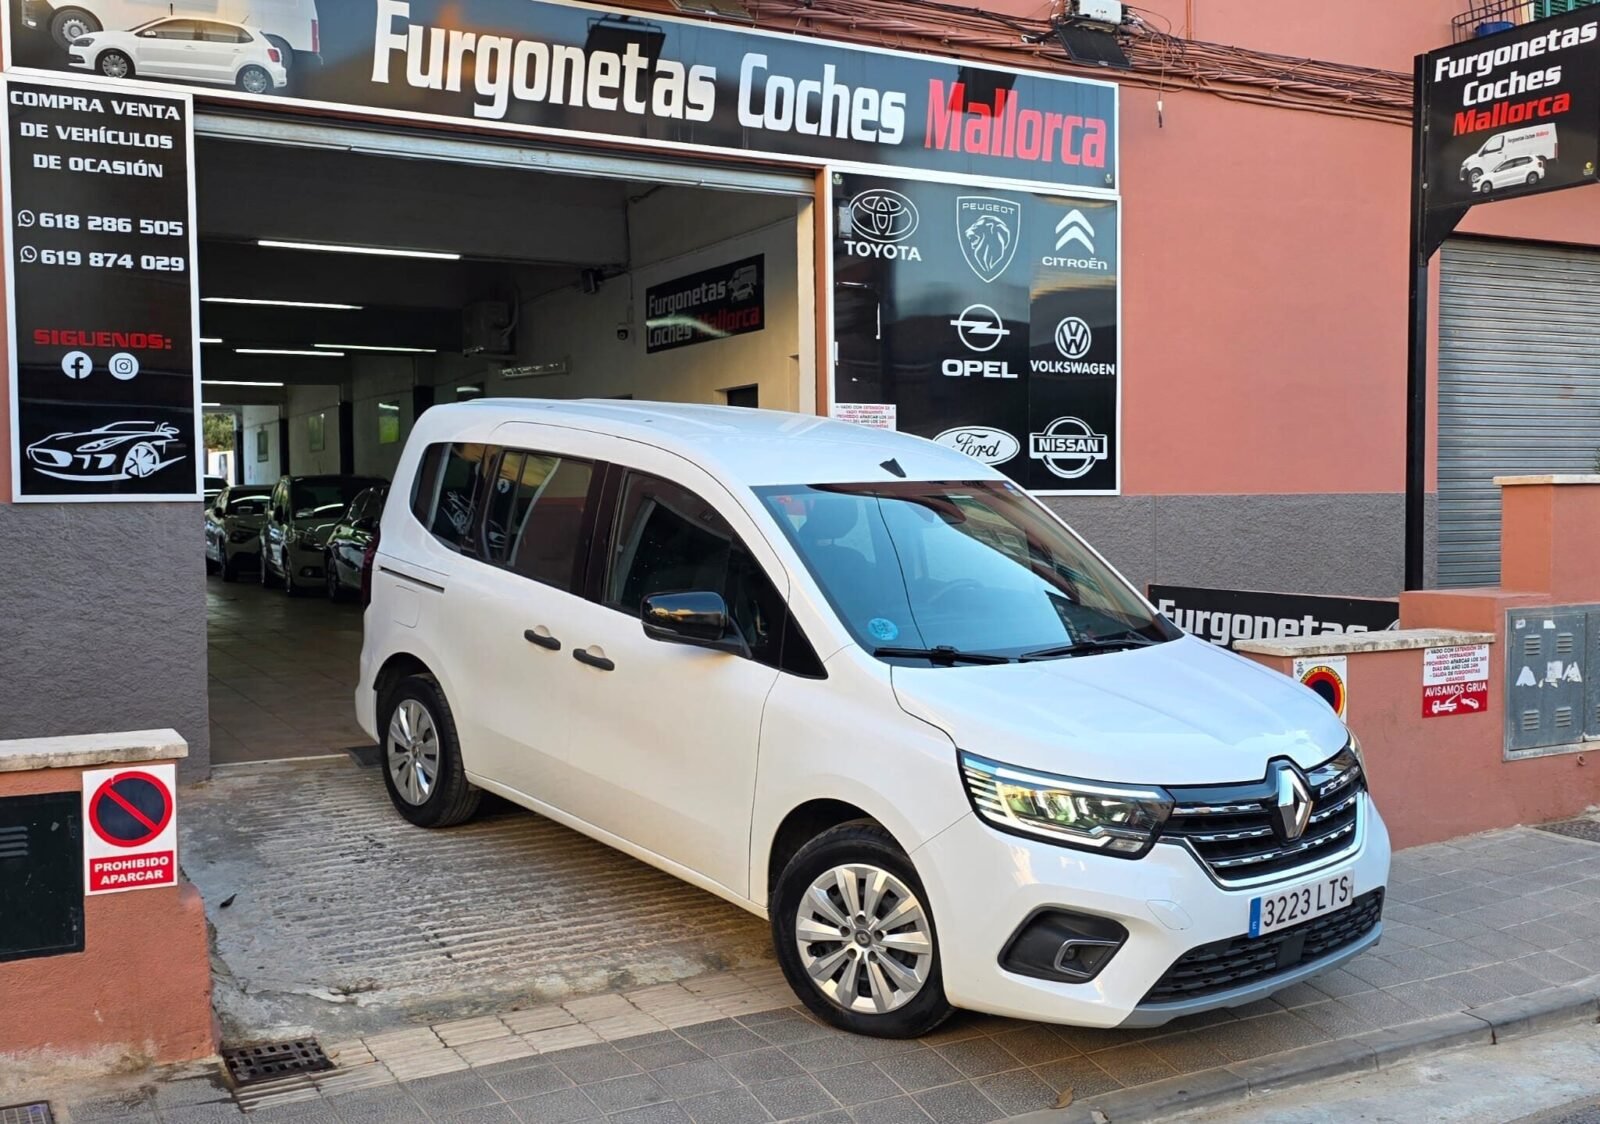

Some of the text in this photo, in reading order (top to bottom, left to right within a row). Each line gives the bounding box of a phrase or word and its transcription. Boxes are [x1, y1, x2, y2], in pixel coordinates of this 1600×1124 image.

[1434, 21, 1598, 82] Furgonetas
[371, 0, 1107, 168] Furgonetas Coches Mallorca
[1463, 65, 1562, 106] Coches
[10, 90, 181, 120] COMPRA VENTA
[1453, 92, 1571, 136] Mallorca
[20, 122, 173, 149] DE VEHÍCULOS
[33, 154, 163, 178] DE OCASIÓN
[962, 202, 1015, 215] PEUGEOT
[39, 212, 183, 236] 618 286 505
[40, 249, 185, 271] 619 874 029
[843, 240, 922, 262] TOYOTA
[648, 281, 726, 318] Furgonetas
[33, 328, 172, 349] SIGUENOS:
[941, 358, 1018, 379] OPEL
[1030, 359, 1115, 375] VOLKSWAGEN
[952, 432, 1001, 457] Ford
[1038, 438, 1098, 452] NISSAN
[1159, 599, 1368, 645] Furgonet
[1424, 681, 1487, 697] AVISAMOS GRUA
[94, 856, 169, 873] PROHIBIDO
[100, 869, 163, 885] APARCAR
[1263, 875, 1349, 927] 3223 LTS
